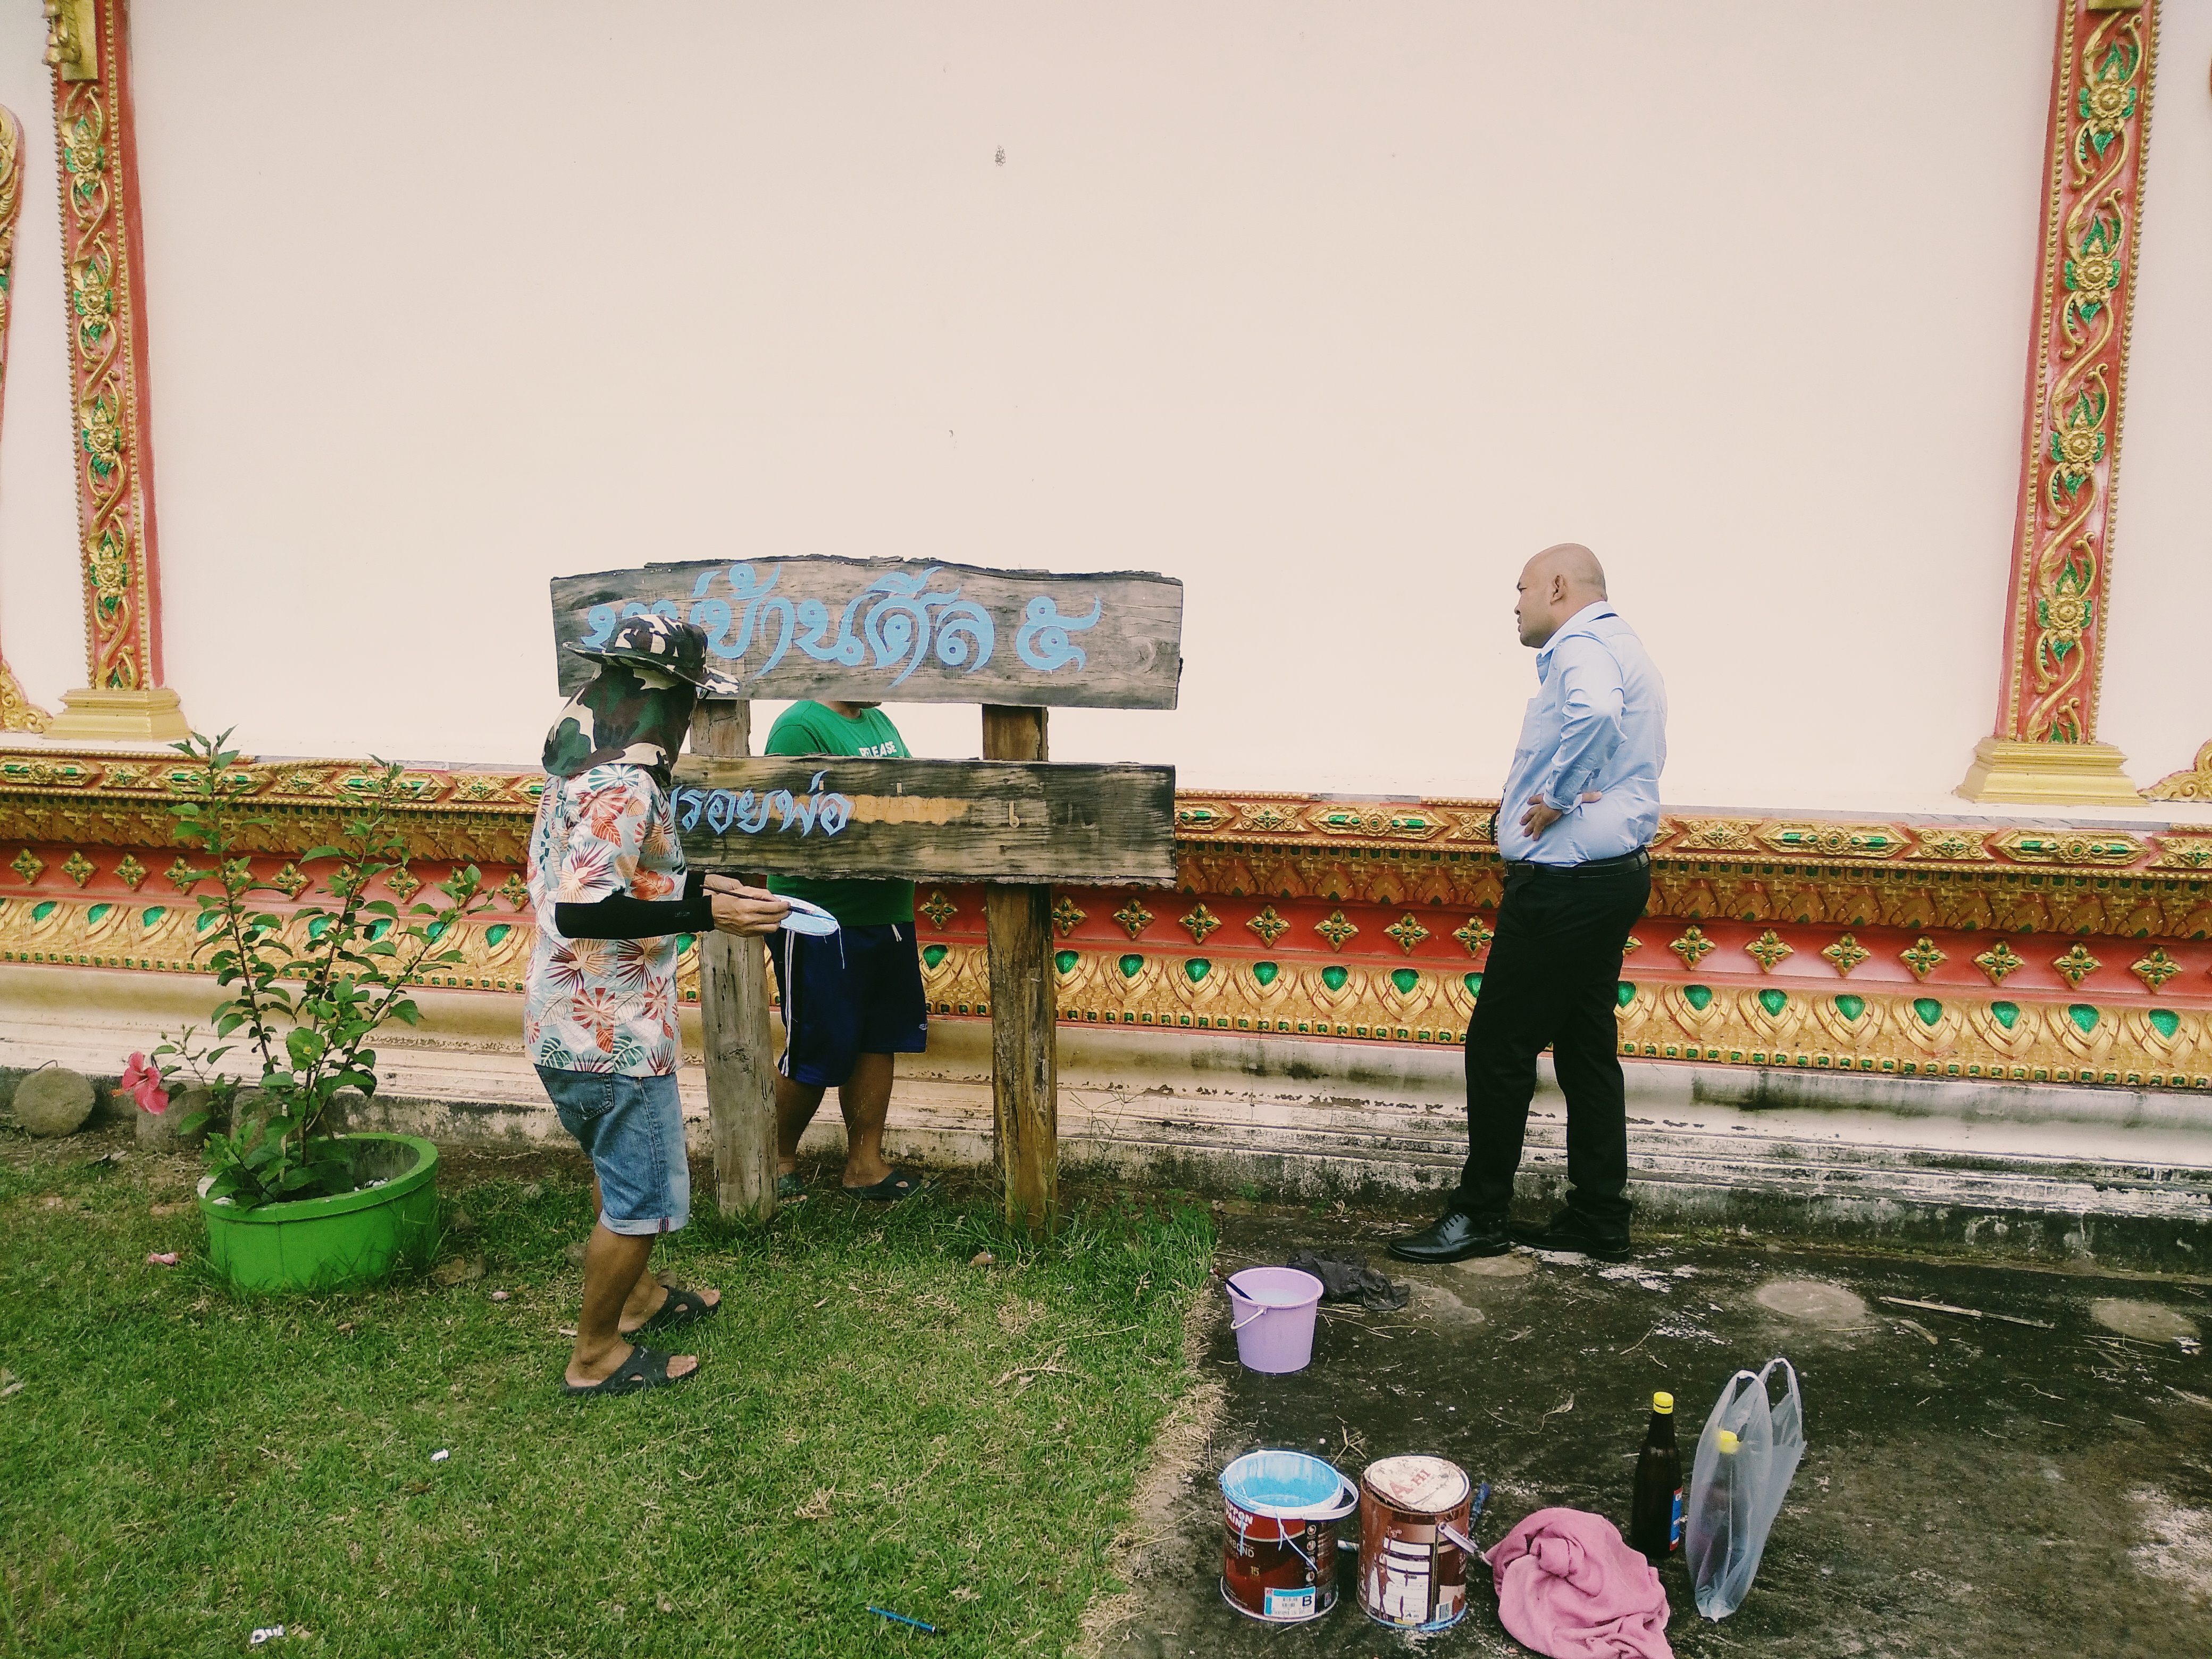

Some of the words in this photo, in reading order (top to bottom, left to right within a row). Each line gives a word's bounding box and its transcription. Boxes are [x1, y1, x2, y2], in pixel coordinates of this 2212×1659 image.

[1016, 594, 1101, 672] ๕
[858, 741, 897, 757] RELEASE
[1226, 1508, 1249, 1531] PAINT
[1302, 1595, 1312, 1606] B
